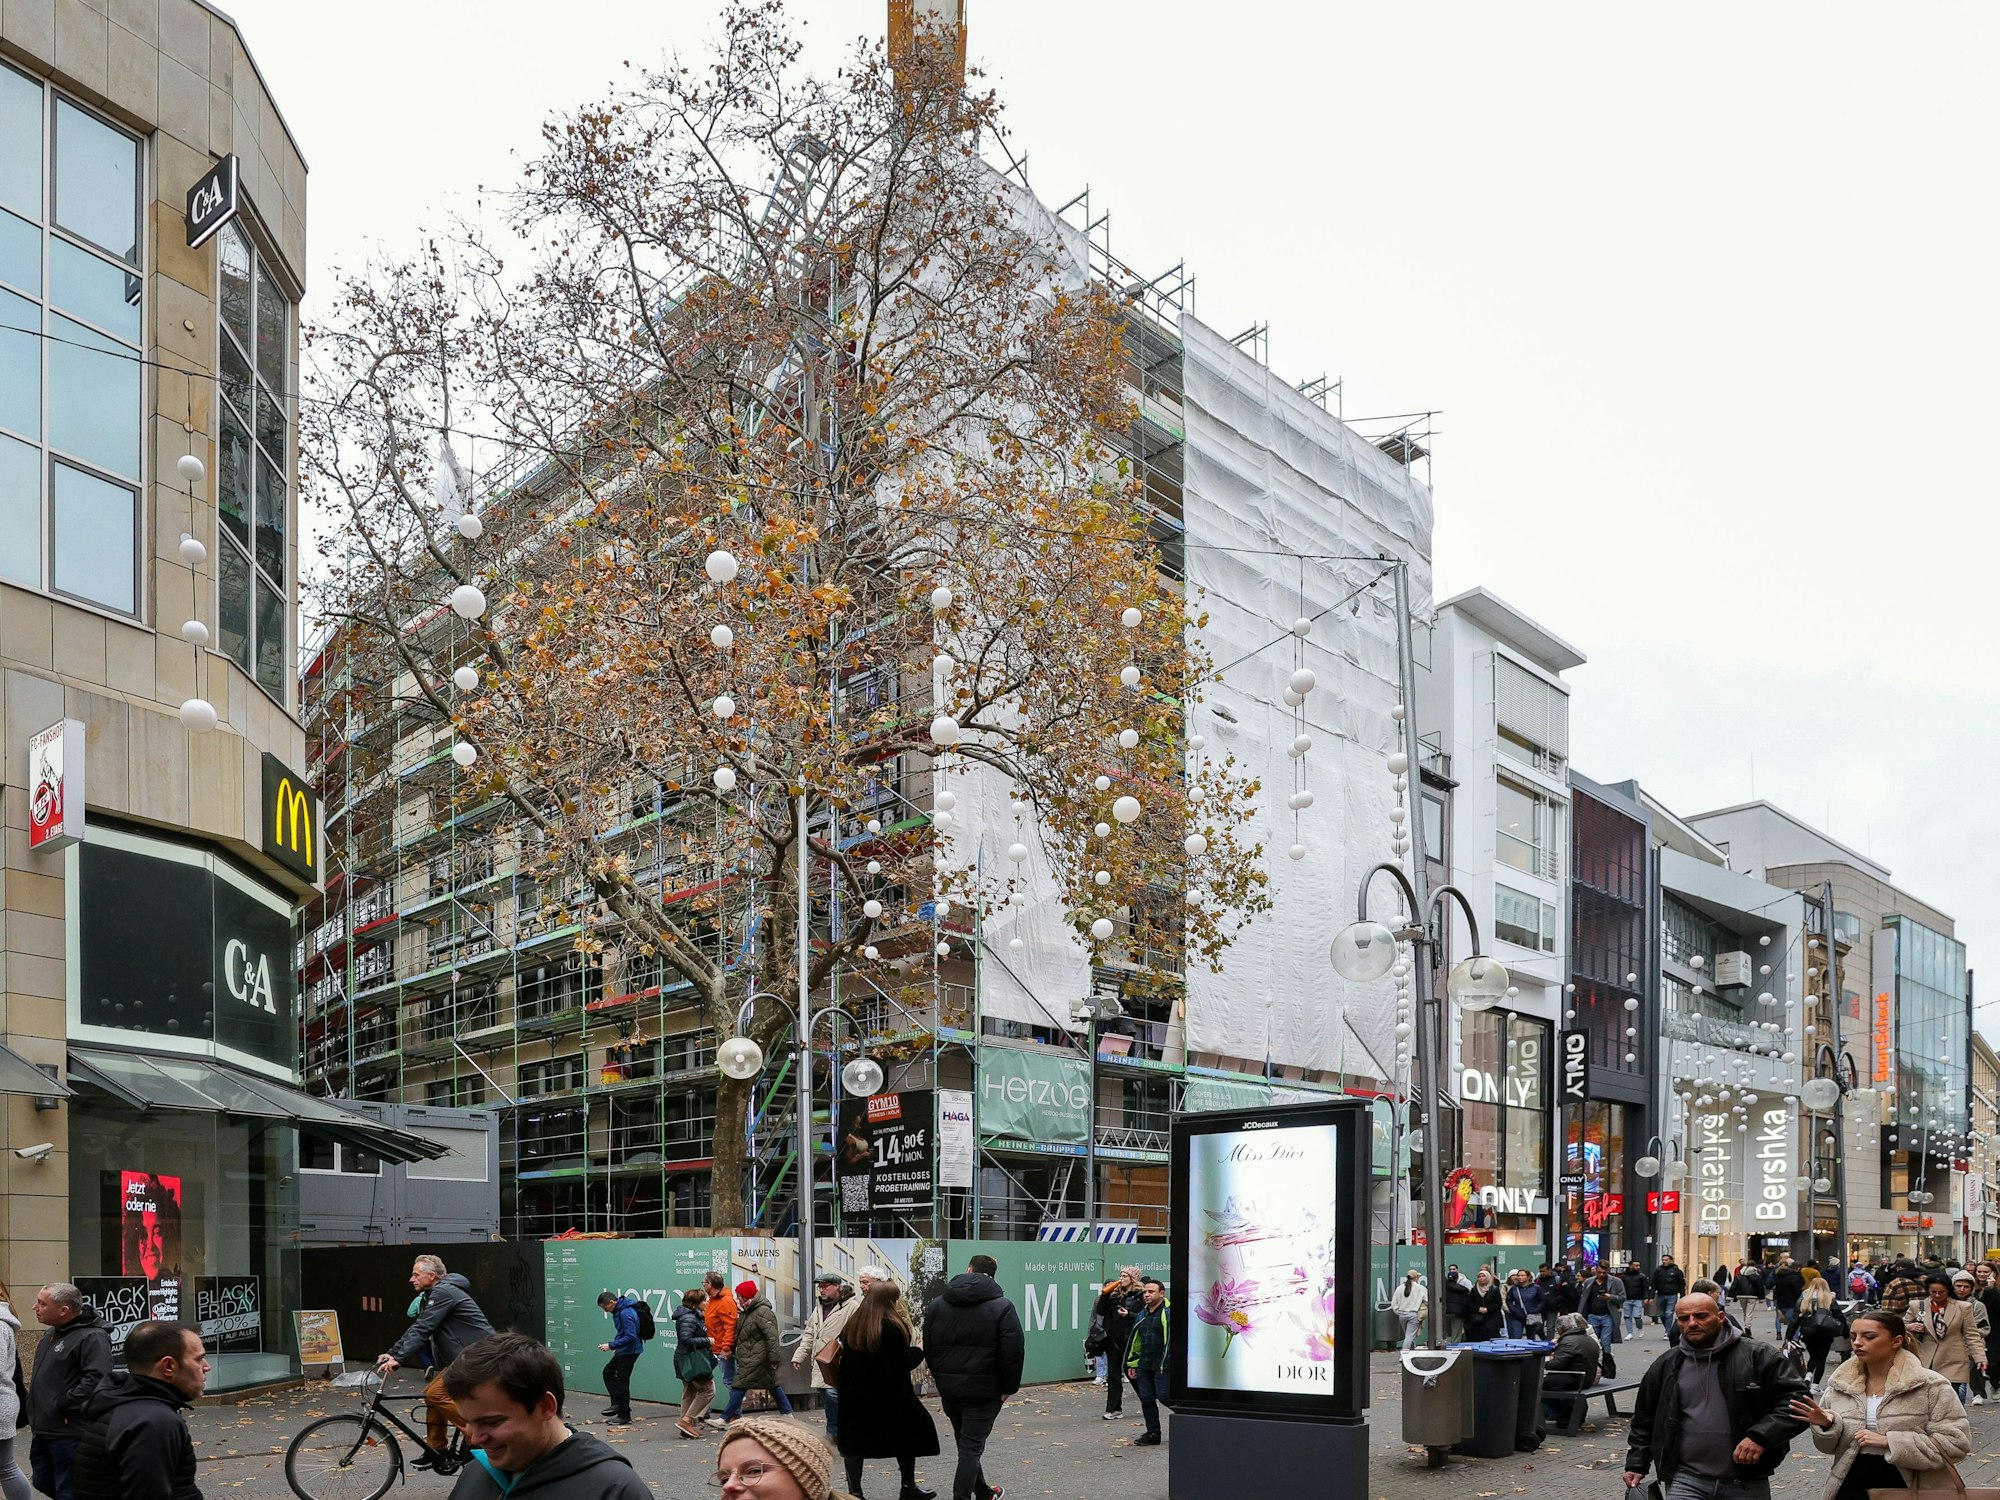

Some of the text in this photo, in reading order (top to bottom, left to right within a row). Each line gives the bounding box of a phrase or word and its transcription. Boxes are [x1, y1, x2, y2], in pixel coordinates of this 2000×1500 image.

[192, 175, 224, 224] C&A
[31, 723, 63, 752] FC-FANSHOP
[51, 822, 63, 837] ETAGE
[224, 938, 276, 1015] C&A
[1566, 1034, 1585, 1098] ONLY
[1462, 1068, 1532, 1108] ONLY
[868, 1095, 898, 1110] GYM10
[943, 1111, 969, 1121] HAGA
[1242, 1121, 1278, 1130] JCDecaux
[998, 1140, 1076, 1154] HEINEN-GRUPPE
[1218, 1142, 1304, 1164] Miss Dior
[905, 1150, 924, 1162] MON.
[1756, 1110, 1787, 1220] Bershka
[876, 1171, 931, 1182] KOSTENLOSES
[126, 1180, 146, 1195] Jetzt
[875, 1182, 931, 1193] PROBETRAINING
[126, 1198, 156, 1212] oder nie
[1481, 1185, 1537, 1213] ONLY
[738, 1249, 780, 1257] BAUWENS
[1025, 1262, 1095, 1274] Made by BAUWENS
[197, 1282, 255, 1306] BLACK
[198, 1297, 255, 1321] FRIDAY
[207, 1315, 248, 1333] -20%
[225, 1332, 237, 1340] AUF
[239, 1328, 257, 1337] ALLES
[1278, 1364, 1327, 1381] DIOR
